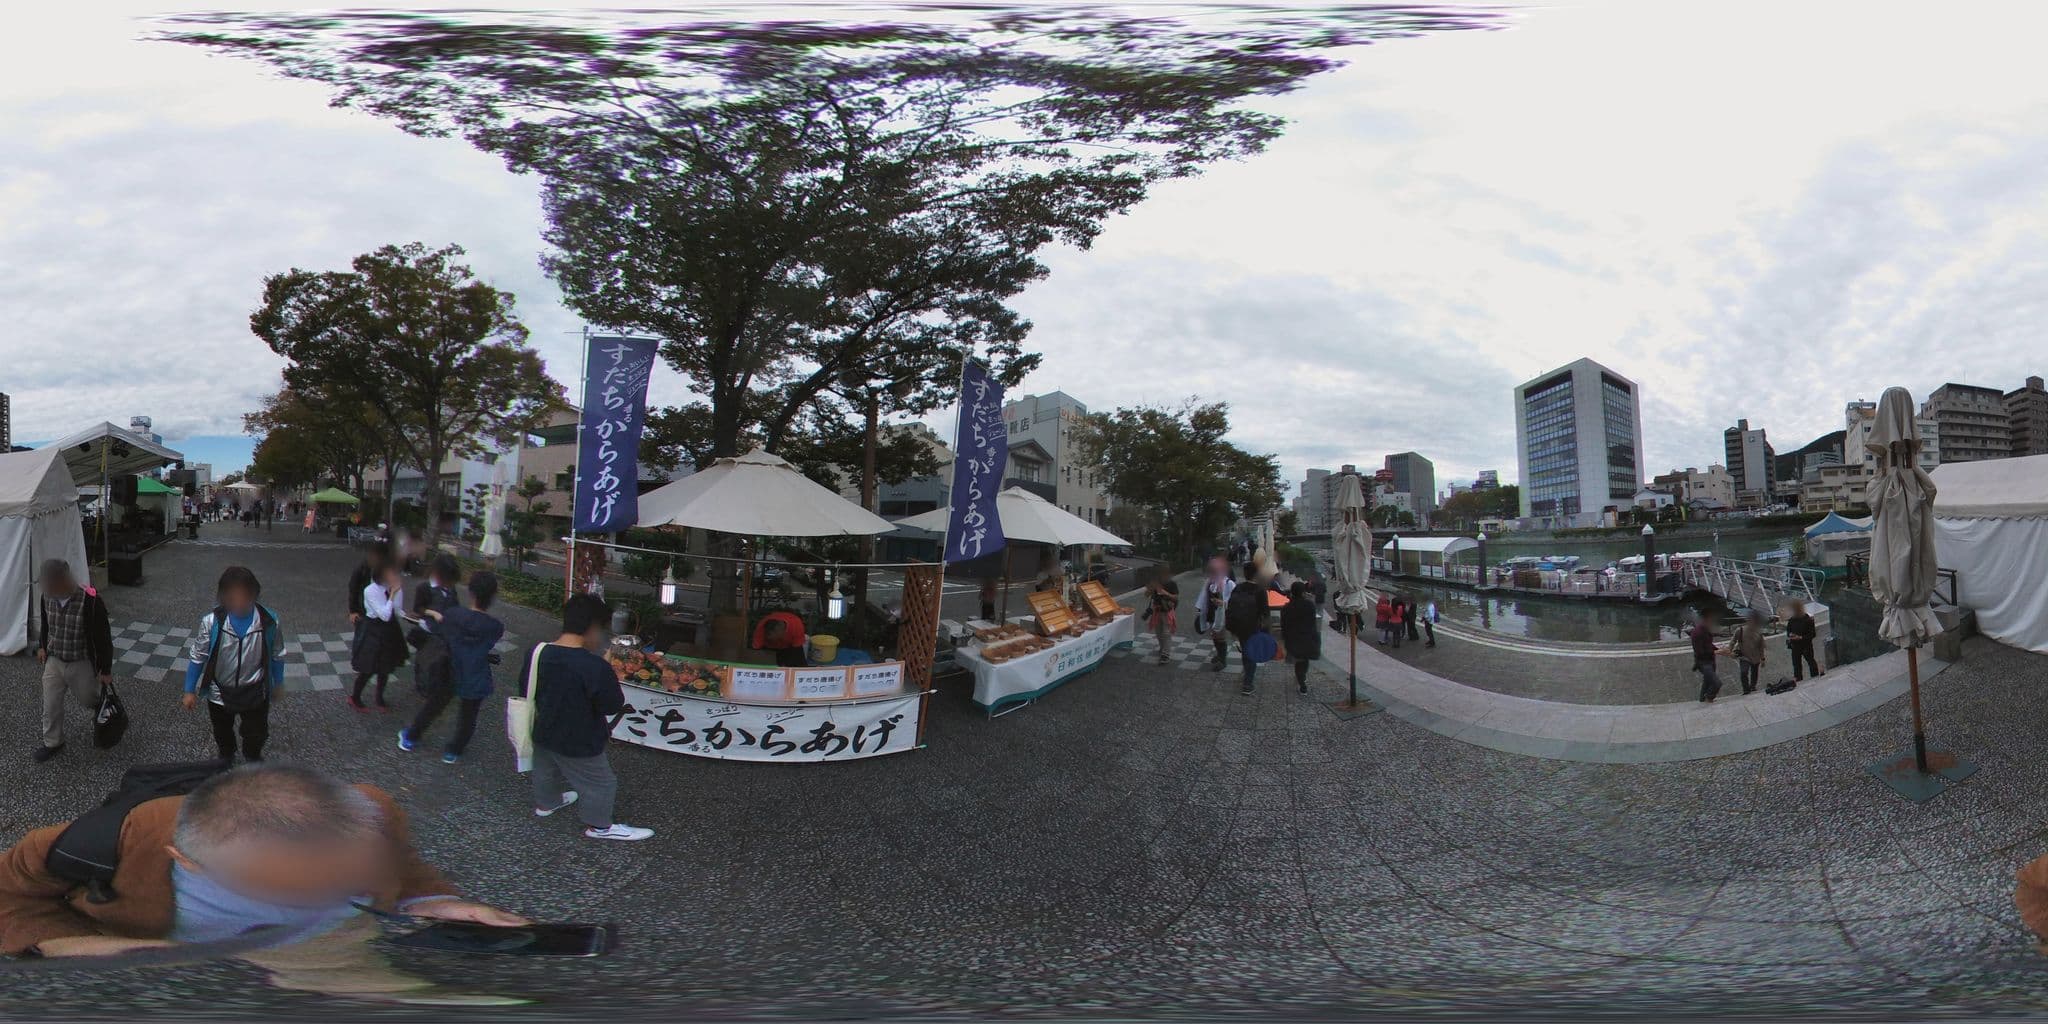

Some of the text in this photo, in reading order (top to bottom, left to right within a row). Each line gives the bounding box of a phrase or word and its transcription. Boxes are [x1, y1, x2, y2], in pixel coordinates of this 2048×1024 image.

[591, 343, 634, 527] すだちからあげ
[960, 379, 991, 558] すだちからあげ
